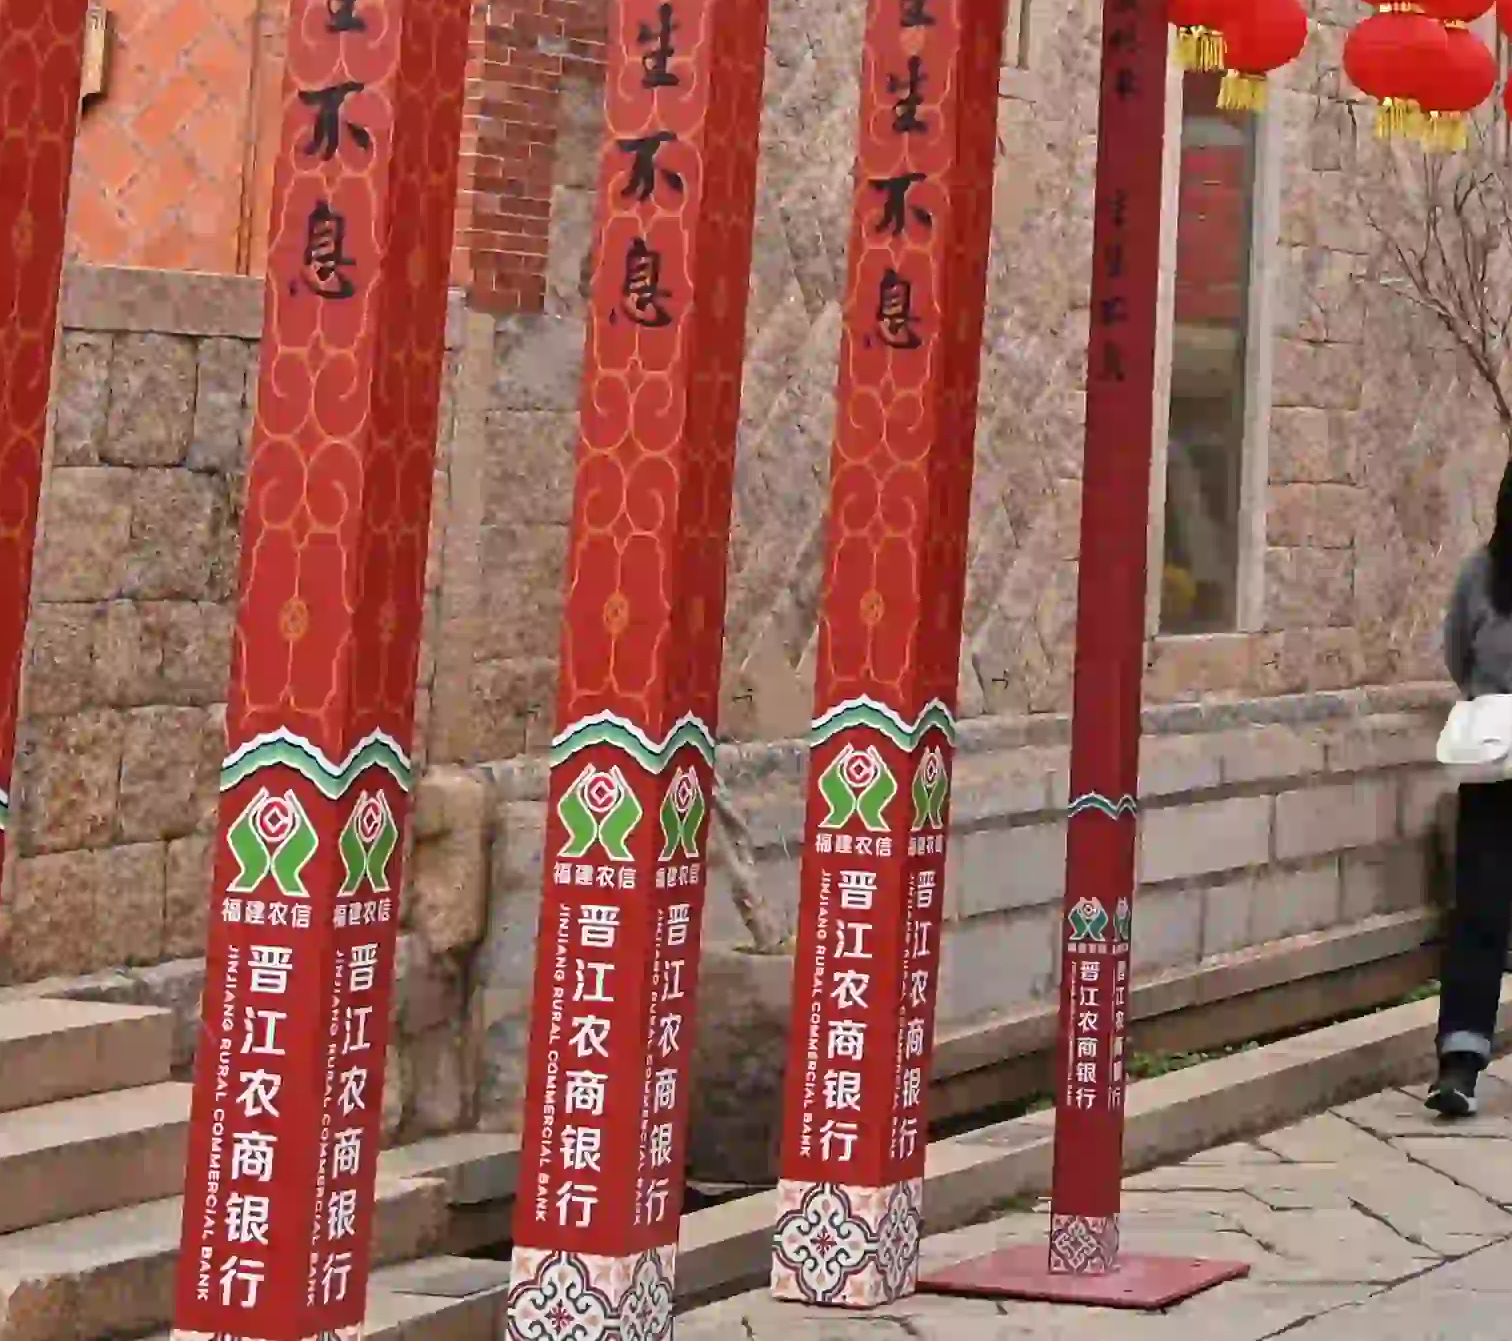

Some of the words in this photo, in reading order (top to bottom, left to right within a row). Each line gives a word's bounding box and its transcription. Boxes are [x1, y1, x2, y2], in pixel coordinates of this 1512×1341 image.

[553, 863, 637, 889] 福建农信
[816, 833, 892, 857] 福建农信
[222, 898, 311, 929] 福建农信
[333, 898, 392, 928] 福建农信
[816, 869, 832, 938] JINJIANG
[553, 903, 571, 981] JINJIANG
[812, 944, 827, 997] RURAL
[221, 944, 240, 1031] JINJIANG
[329, 950, 345, 1035] JINJIANG
[549, 988, 564, 1043] RURAL
[820, 870, 877, 1161] 晋江农商银行
[215, 1039, 232, 1101] RURAL
[556, 904, 620, 1227] 晋江农商银行
[646, 903, 689, 1224] 晋江农商银行
[803, 1001, 821, 1107] COMMERCIAL
[1076, 961, 1100, 1110] 晋江农商银行
[323, 1043, 337, 1107] RURAL
[539, 1050, 559, 1166] COMMERCIAL
[219, 944, 293, 1307] 晋江农商银行
[321, 942, 378, 1305] 晋江农商银行
[799, 1113, 813, 1155] BANK
[202, 1108, 225, 1238] COMMERCIAL
[311, 1113, 331, 1245] COMMERCIAL
[535, 1172, 550, 1221] BANK
[197, 1246, 213, 1300] BANK
[306, 1252, 319, 1306] BANK
